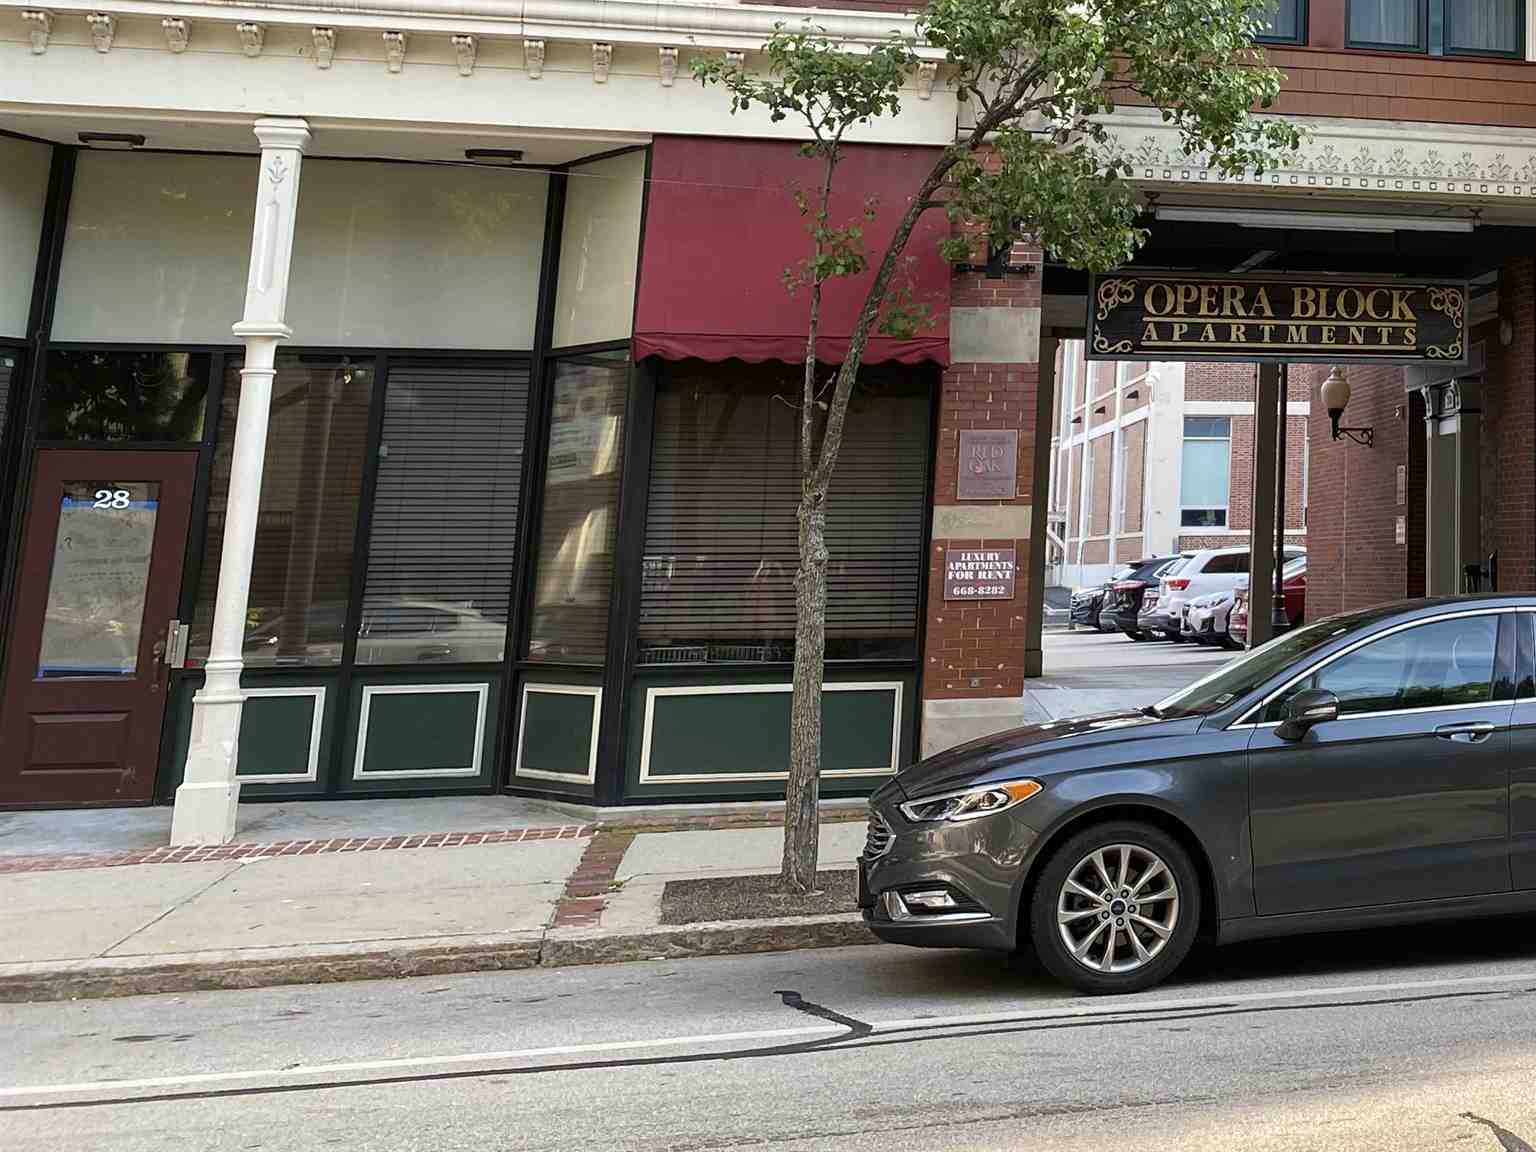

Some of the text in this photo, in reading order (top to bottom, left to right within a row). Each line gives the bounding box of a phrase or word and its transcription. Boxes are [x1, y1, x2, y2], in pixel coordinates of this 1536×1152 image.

[1143, 283, 1417, 321] OPERA BLOCK
[1142, 321, 1417, 346] APARTMENTS
[93, 489, 130, 509] 28
[961, 552, 1001, 561] LUXURY
[948, 561, 1014, 571] APARTMENTS
[947, 570, 1012, 580] FOR RENT
